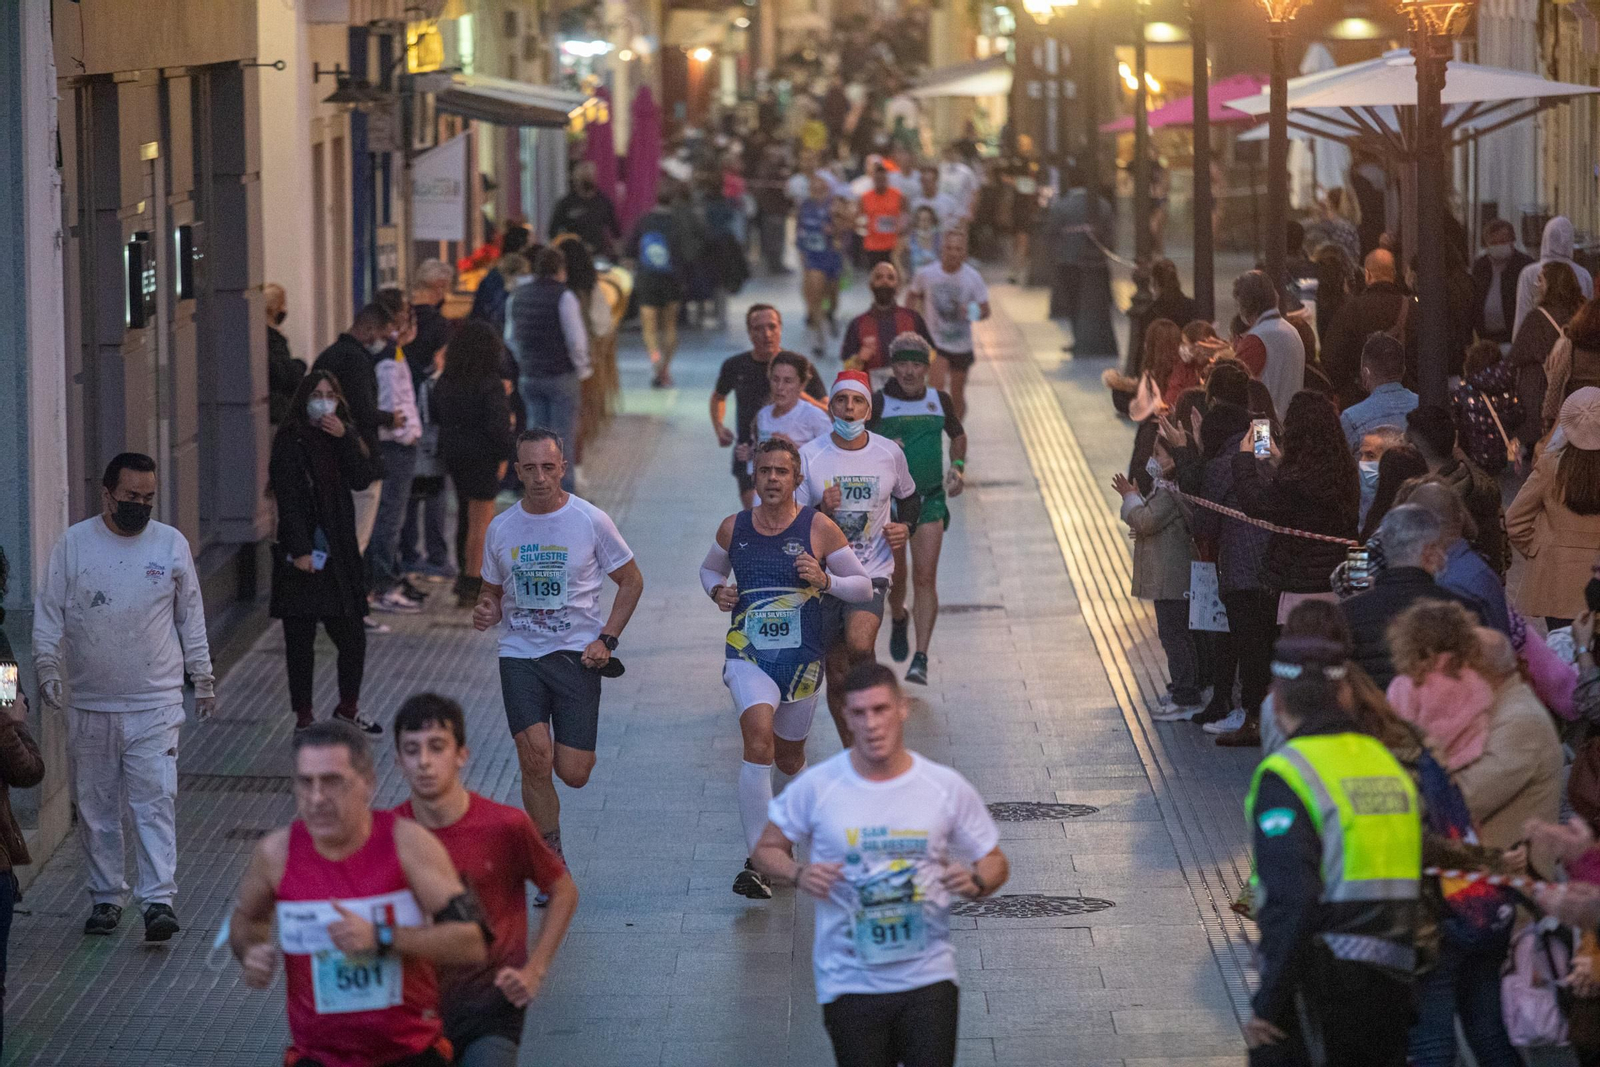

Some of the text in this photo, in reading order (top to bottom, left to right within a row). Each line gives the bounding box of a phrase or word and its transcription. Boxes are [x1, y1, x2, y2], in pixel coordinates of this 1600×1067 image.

[844, 487, 871, 500] 703
[520, 544, 539, 553] SAN
[520, 551, 568, 563] SILVESTRE
[523, 581, 561, 596] 1139
[758, 622, 790, 637] 499
[845, 827, 859, 847] V
[872, 921, 911, 945] 911
[337, 961, 382, 991] 501
